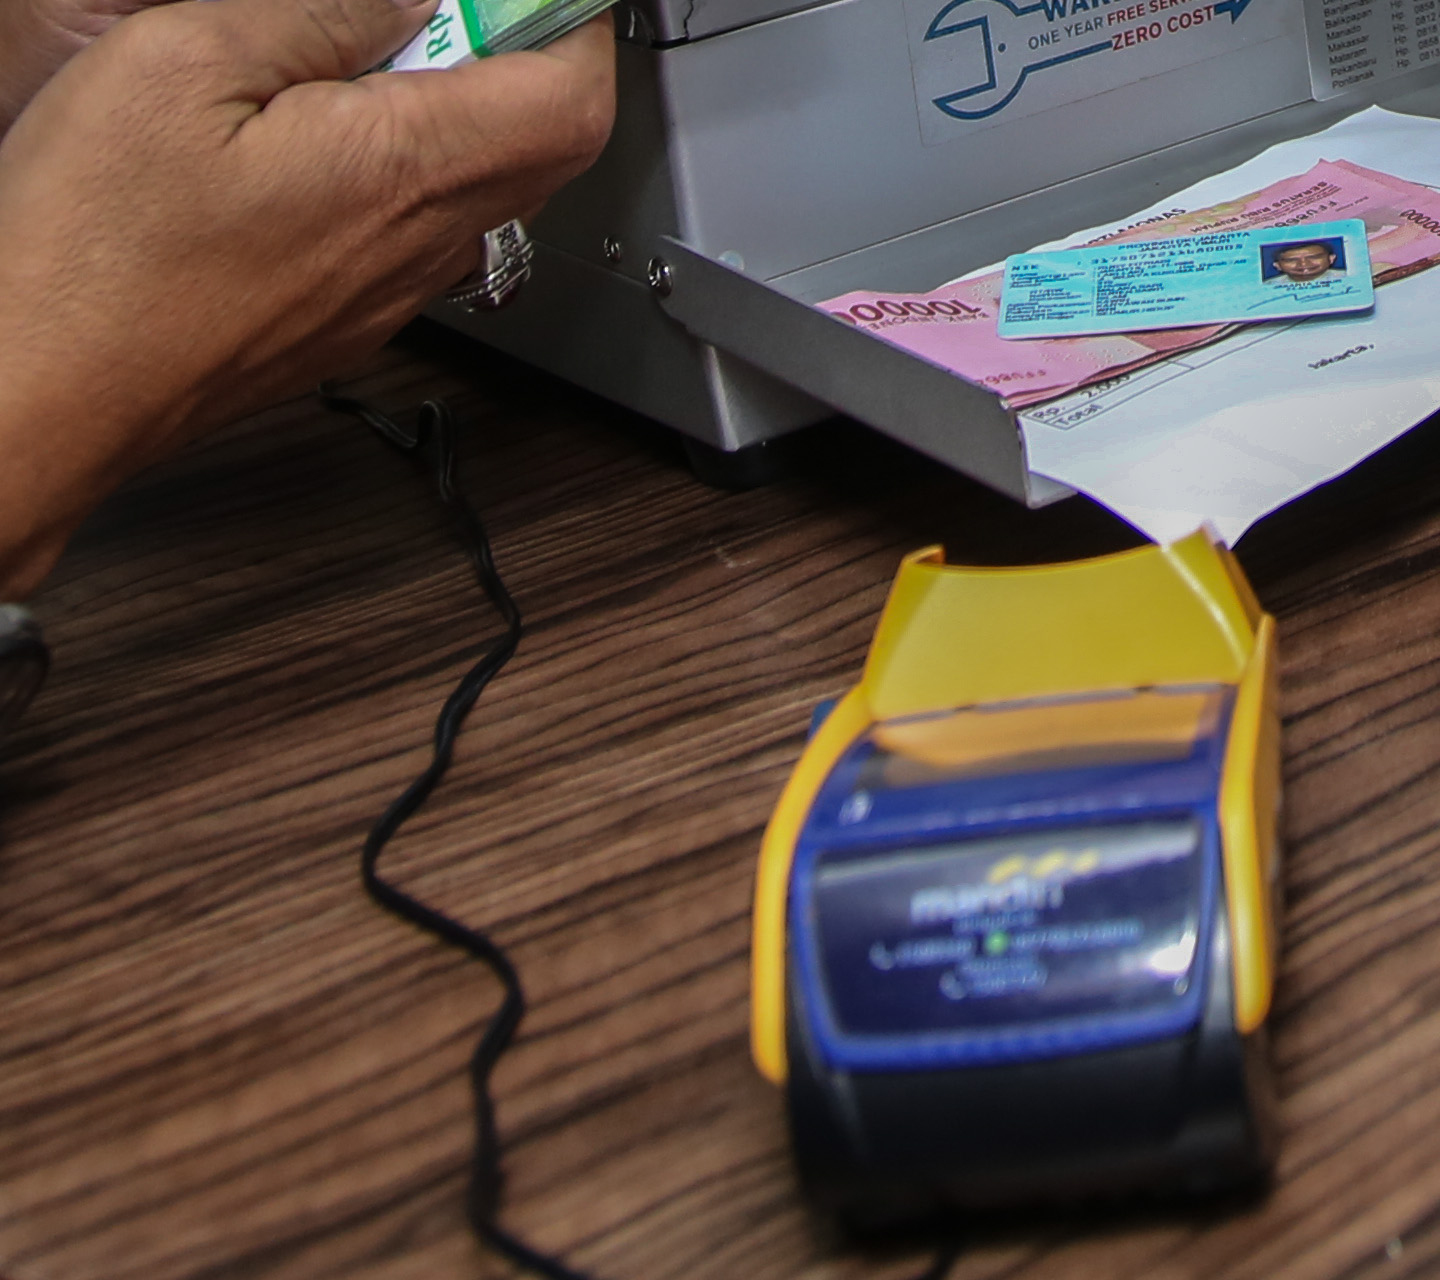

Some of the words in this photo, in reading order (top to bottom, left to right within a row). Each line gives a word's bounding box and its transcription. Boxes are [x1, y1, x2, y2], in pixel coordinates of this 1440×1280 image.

[1027, 29, 1060, 51] ONE
[1064, 16, 1104, 39] YEAR
[1107, 2, 1146, 26] FREE
[1111, 21, 1163, 51] ZERO
[1166, 4, 1216, 34] COST
[1325, 9, 1373, 29] Balikpapan
[1326, 25, 1361, 40] Manado
[1328, 34, 1370, 52] Makassar
[1329, 48, 1368, 64] Mataram
[1331, 57, 1377, 77] Pekanbaru
[1332, 70, 1375, 89] Pontianak
